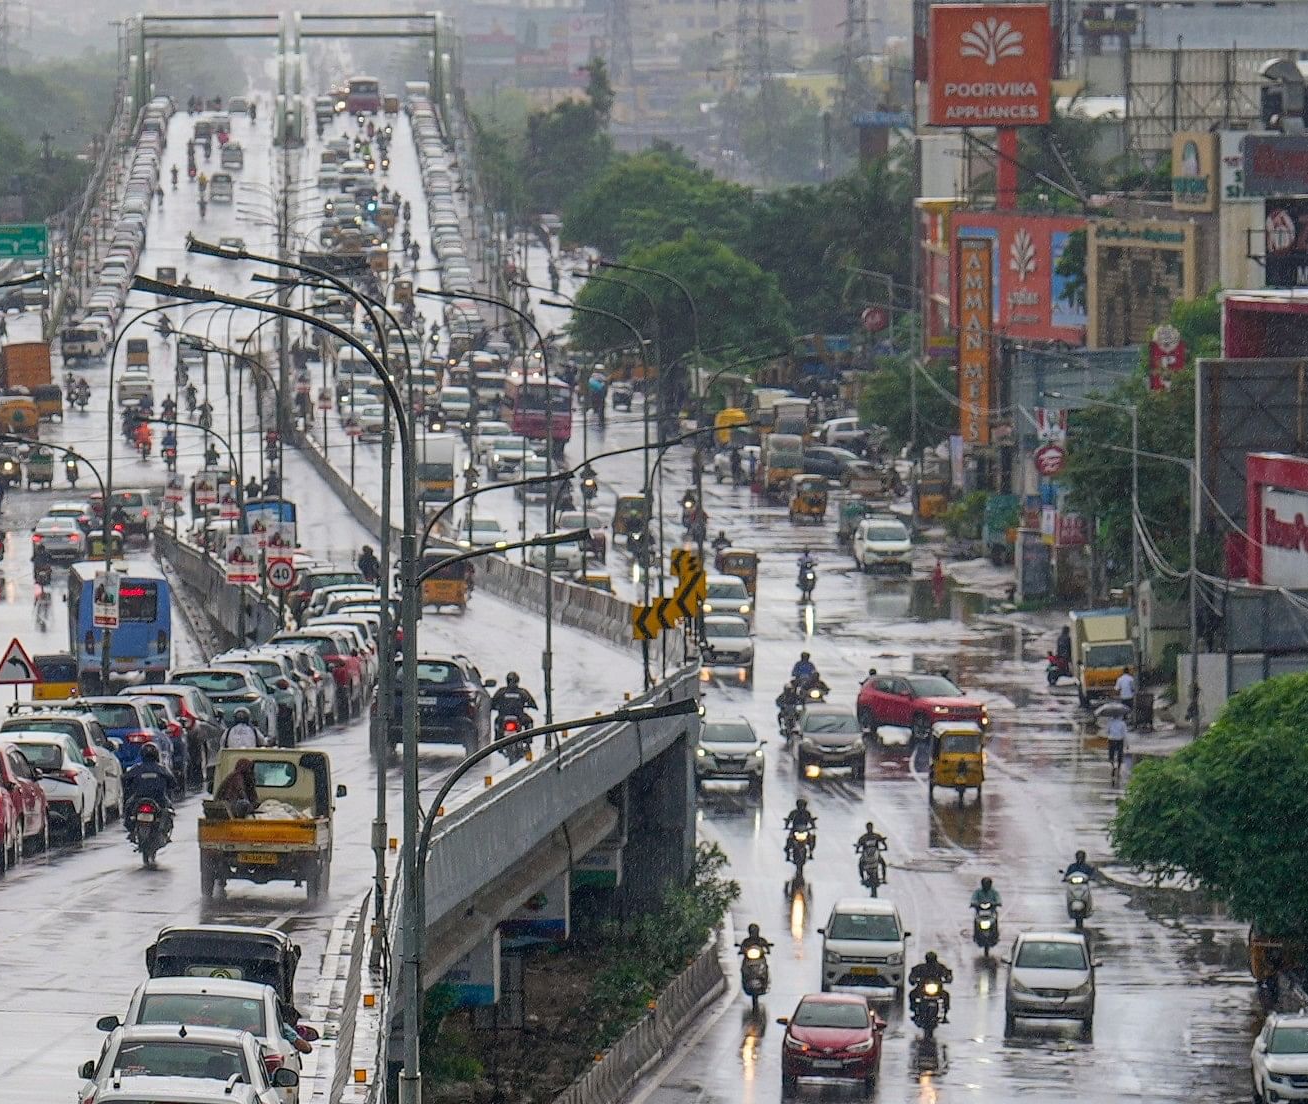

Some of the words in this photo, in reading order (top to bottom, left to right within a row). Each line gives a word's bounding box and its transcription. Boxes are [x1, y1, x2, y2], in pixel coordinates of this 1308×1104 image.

[945, 82, 1038, 97] POORVIKA
[946, 105, 1039, 119] APPLIANCES
[964, 253, 984, 350] AMMAN
[273, 568, 289, 580] 40
